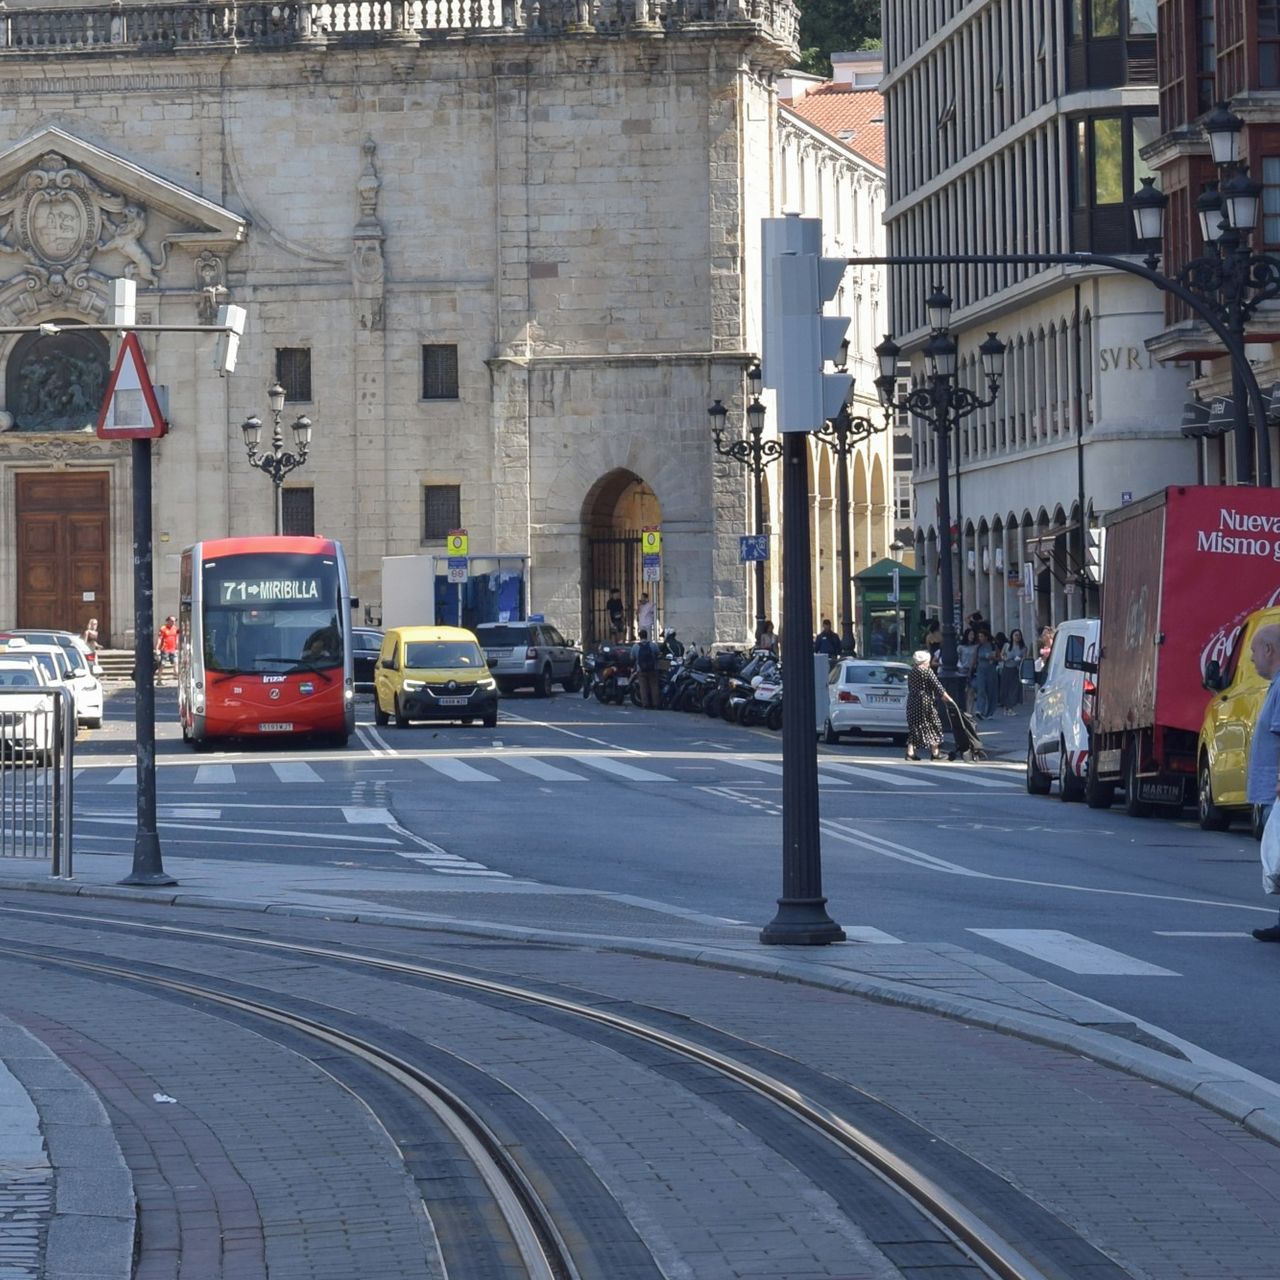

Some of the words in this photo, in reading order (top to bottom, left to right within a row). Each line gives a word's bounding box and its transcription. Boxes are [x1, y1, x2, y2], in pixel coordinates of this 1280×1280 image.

[1197, 531, 1270, 556] Mismo
[223, 582, 247, 600] 71
[259, 580, 318, 600] MIRIBILLA
